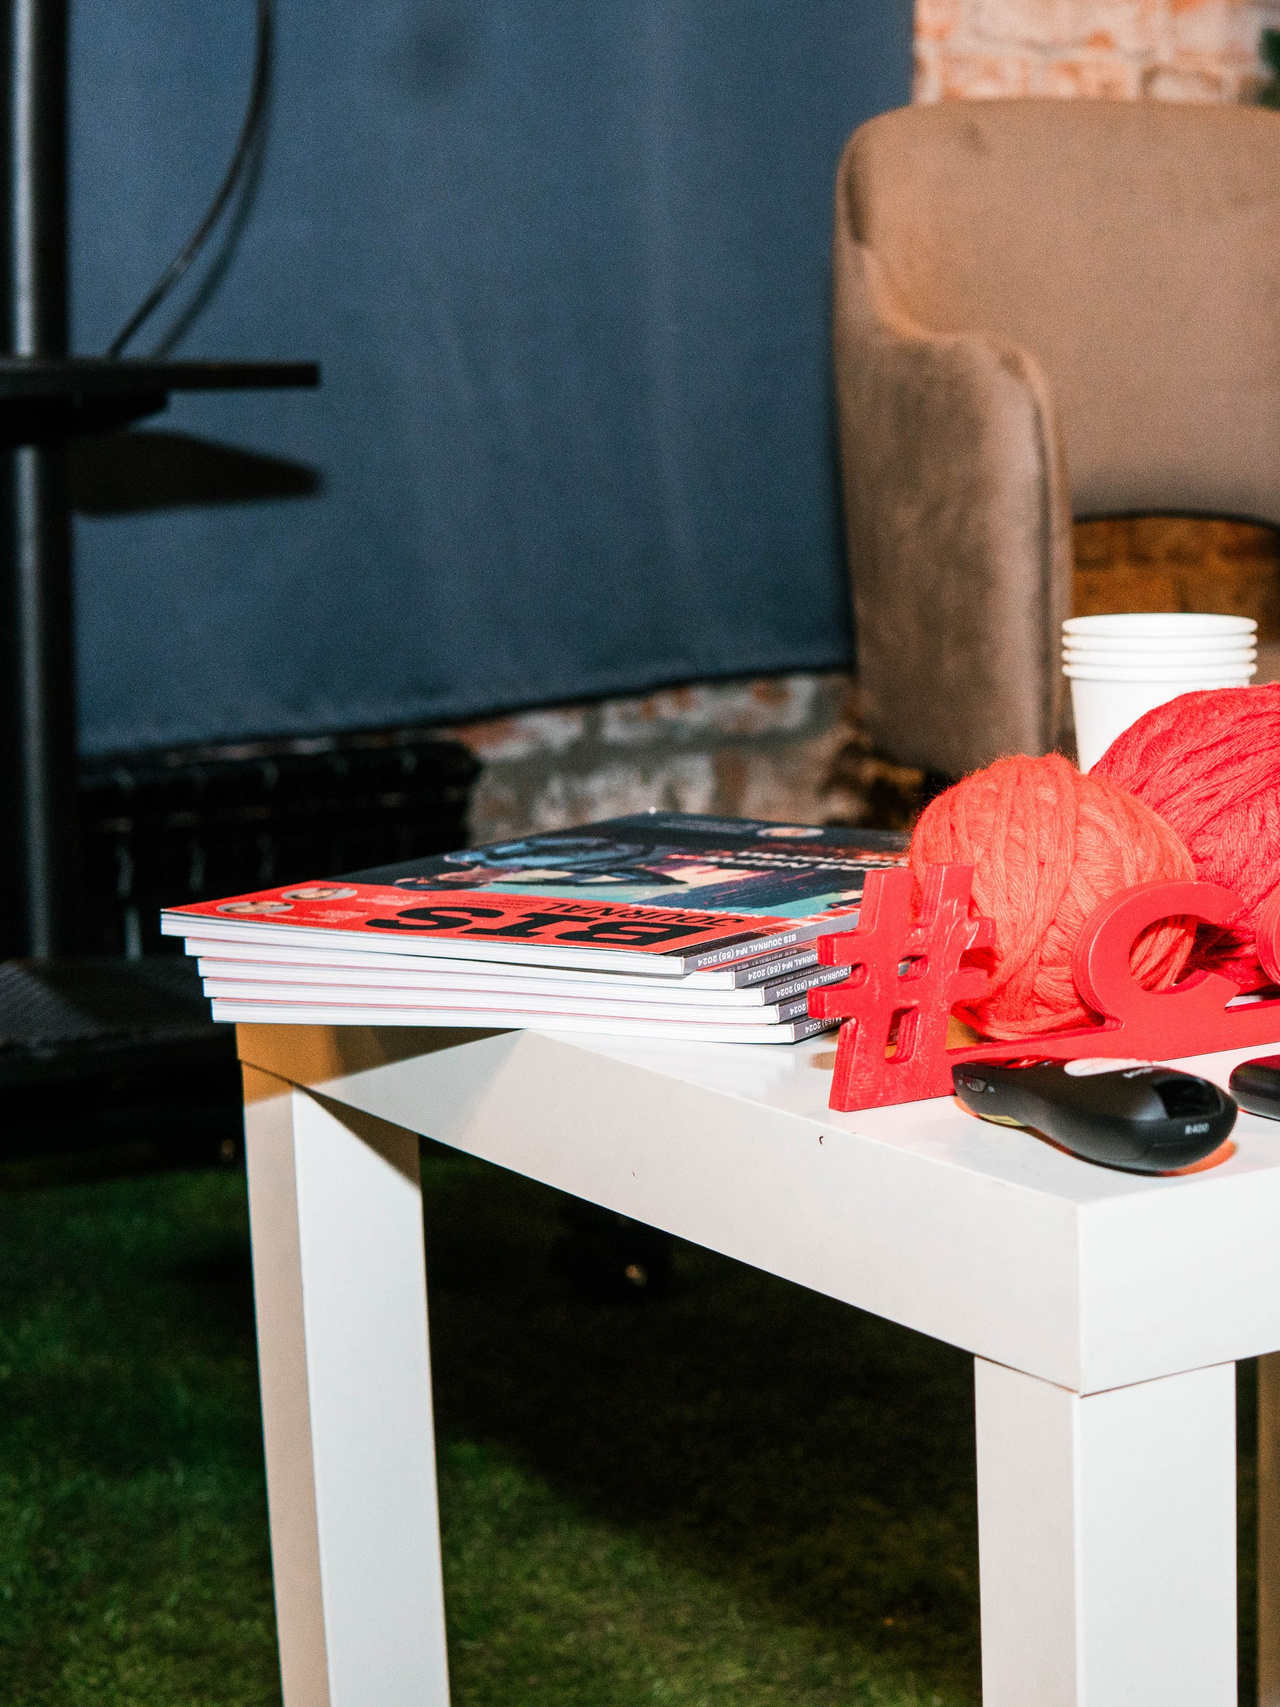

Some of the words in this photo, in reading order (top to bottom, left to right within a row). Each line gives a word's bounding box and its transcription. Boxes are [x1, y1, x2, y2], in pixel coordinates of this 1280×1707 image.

[551, 901, 745, 928] JOURNAL
[365, 905, 715, 947] BIS
[750, 937, 783, 953] JOURNAL
[783, 933, 797, 945] BIS
[697, 955, 718, 968] 2024
[718, 950, 735, 964] (55)
[795, 953, 818, 967] URNAL
[747, 970, 766, 982] 2024
[767, 966, 781, 976] (55)
[820, 968, 849, 983] JOURNAL
[776, 986, 794, 999] 2024
[794, 981, 808, 993] (55)
[789, 1003, 806, 1016] 2024
[805, 1022, 821, 1034] 2024
